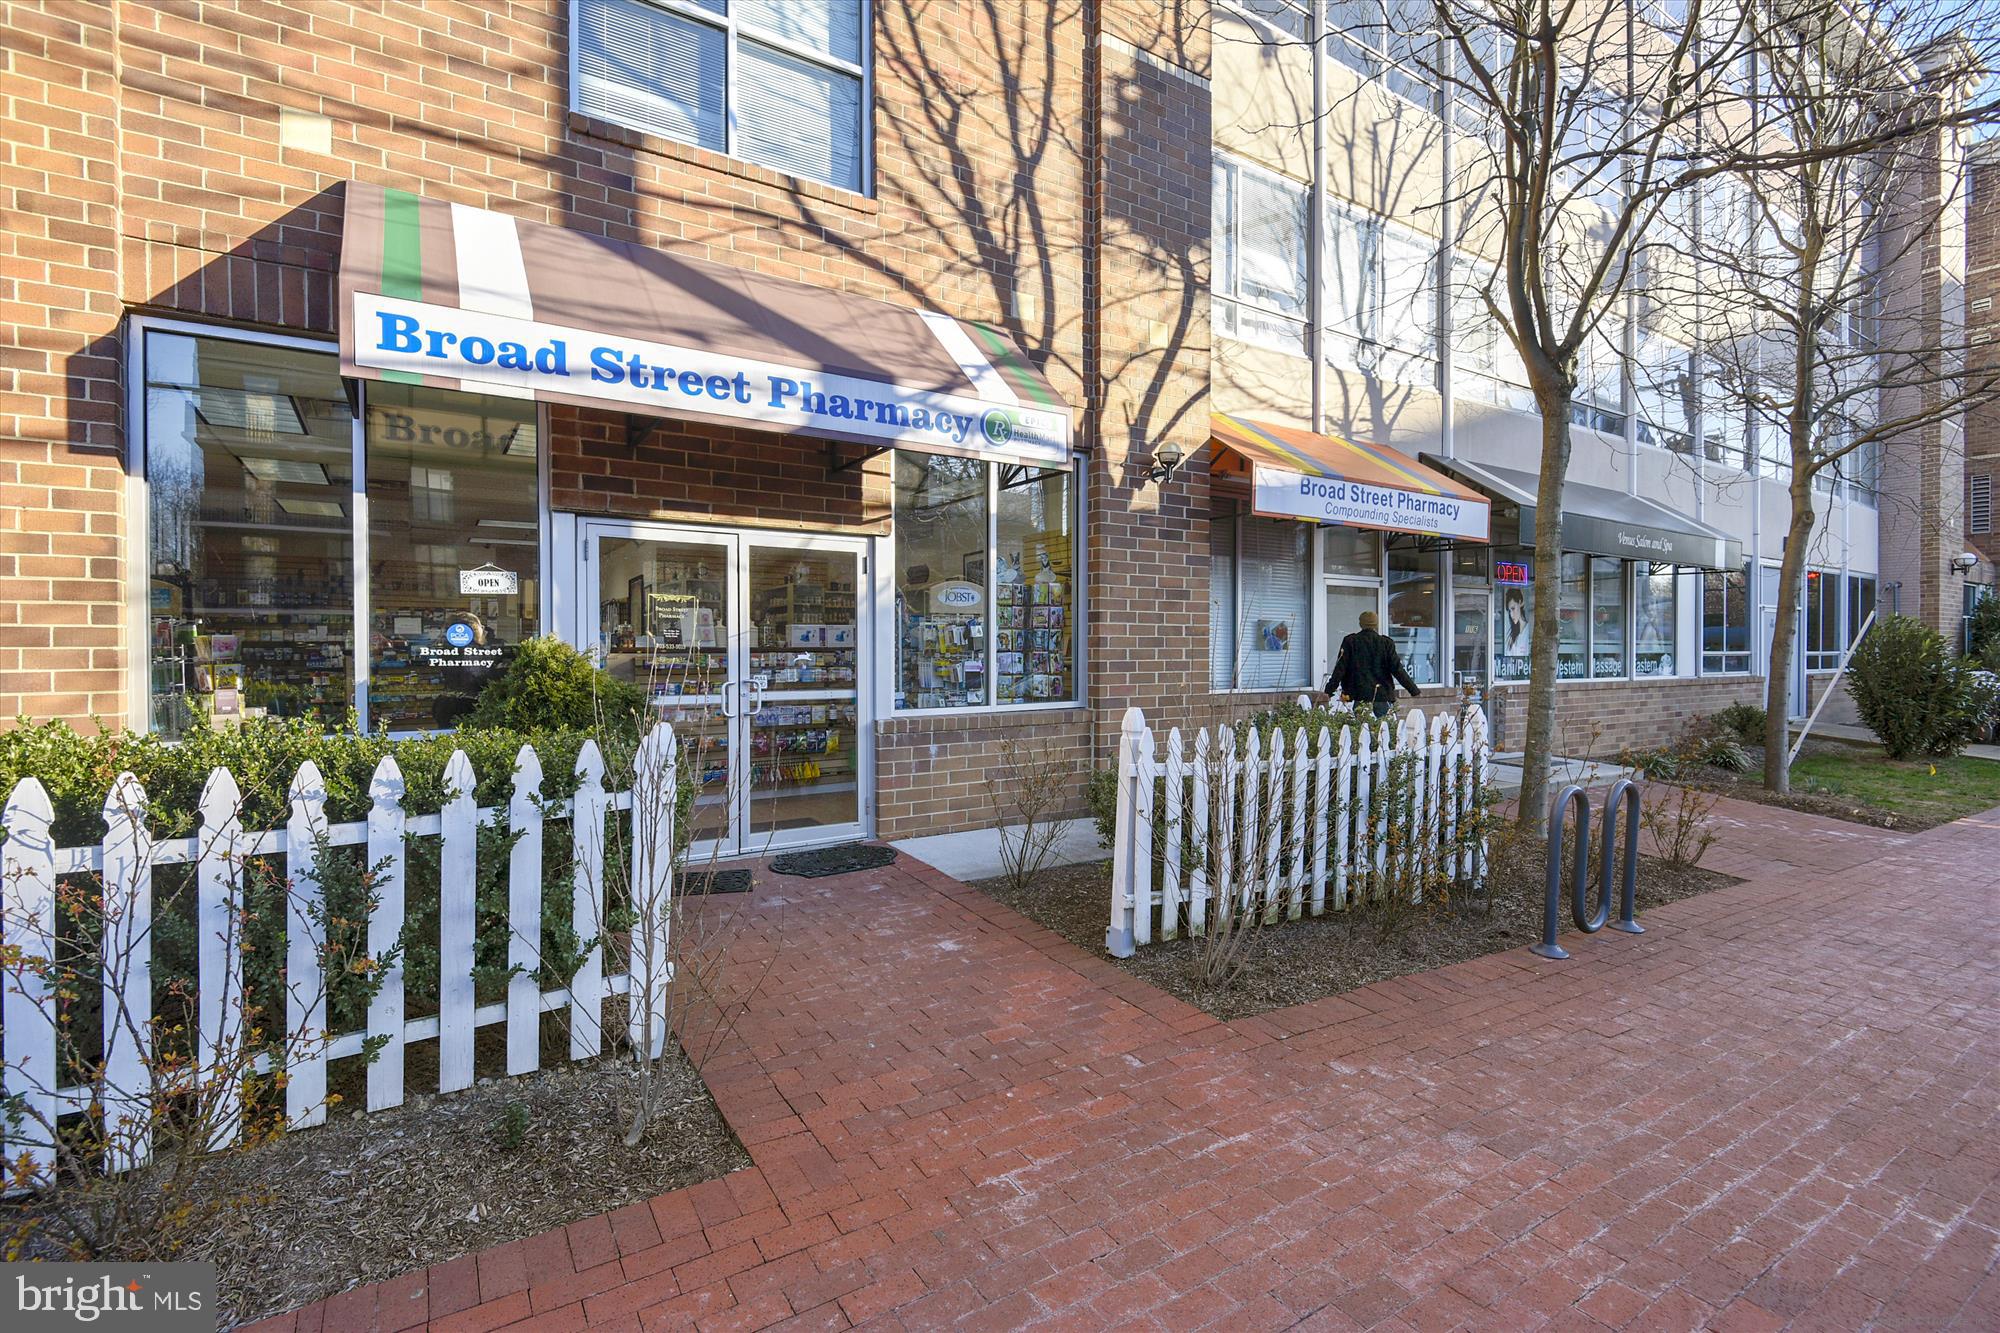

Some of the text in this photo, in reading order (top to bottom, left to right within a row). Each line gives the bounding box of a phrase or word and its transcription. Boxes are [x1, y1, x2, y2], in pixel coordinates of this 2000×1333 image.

[375, 311, 974, 443] Broad Street Pharmacy
[1300, 477, 1461, 521] Broad Street Pharmacy
[1325, 501, 1439, 529] Compounding Specialists
[1662, 539, 1673, 554] Spa
[1497, 564, 1526, 582] OPEN
[478, 578, 499, 587] OPEN
[944, 589, 973, 603] JOBST
[419, 647, 503, 656] Broad Street
[429, 658, 494, 667] Pharmacy
